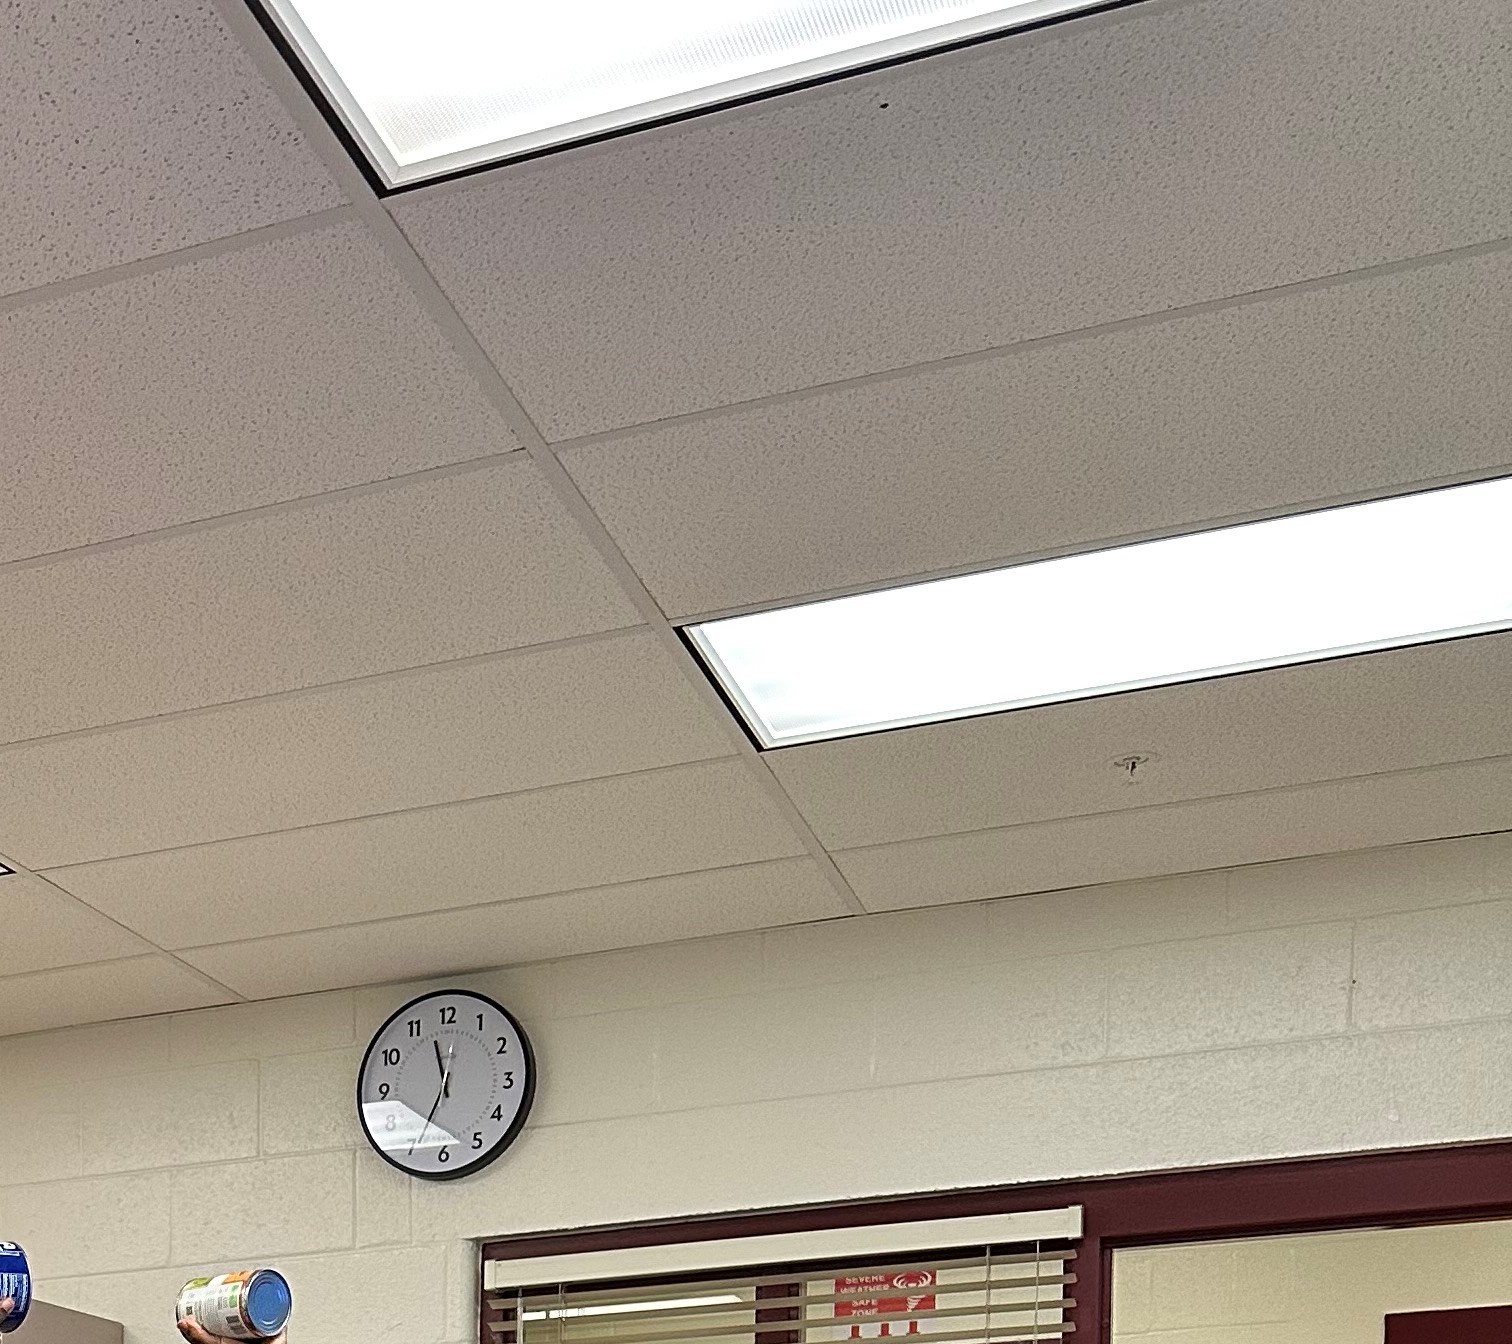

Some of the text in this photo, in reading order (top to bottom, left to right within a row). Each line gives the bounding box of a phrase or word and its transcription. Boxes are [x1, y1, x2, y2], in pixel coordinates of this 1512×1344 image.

[439, 1006, 457, 1025] 12
[476, 1013, 484, 1031] 1
[407, 1019, 422, 1037] 11
[496, 1037, 507, 1055] 2
[381, 1048, 401, 1066] 10
[502, 1071, 514, 1089] 3
[378, 1082, 390, 1101] 9
[490, 1104, 503, 1122] 4
[384, 1114, 396, 1131] 8
[407, 1138, 418, 1156] 7
[471, 1131, 483, 1150] 5
[438, 1145, 450, 1163] 6
